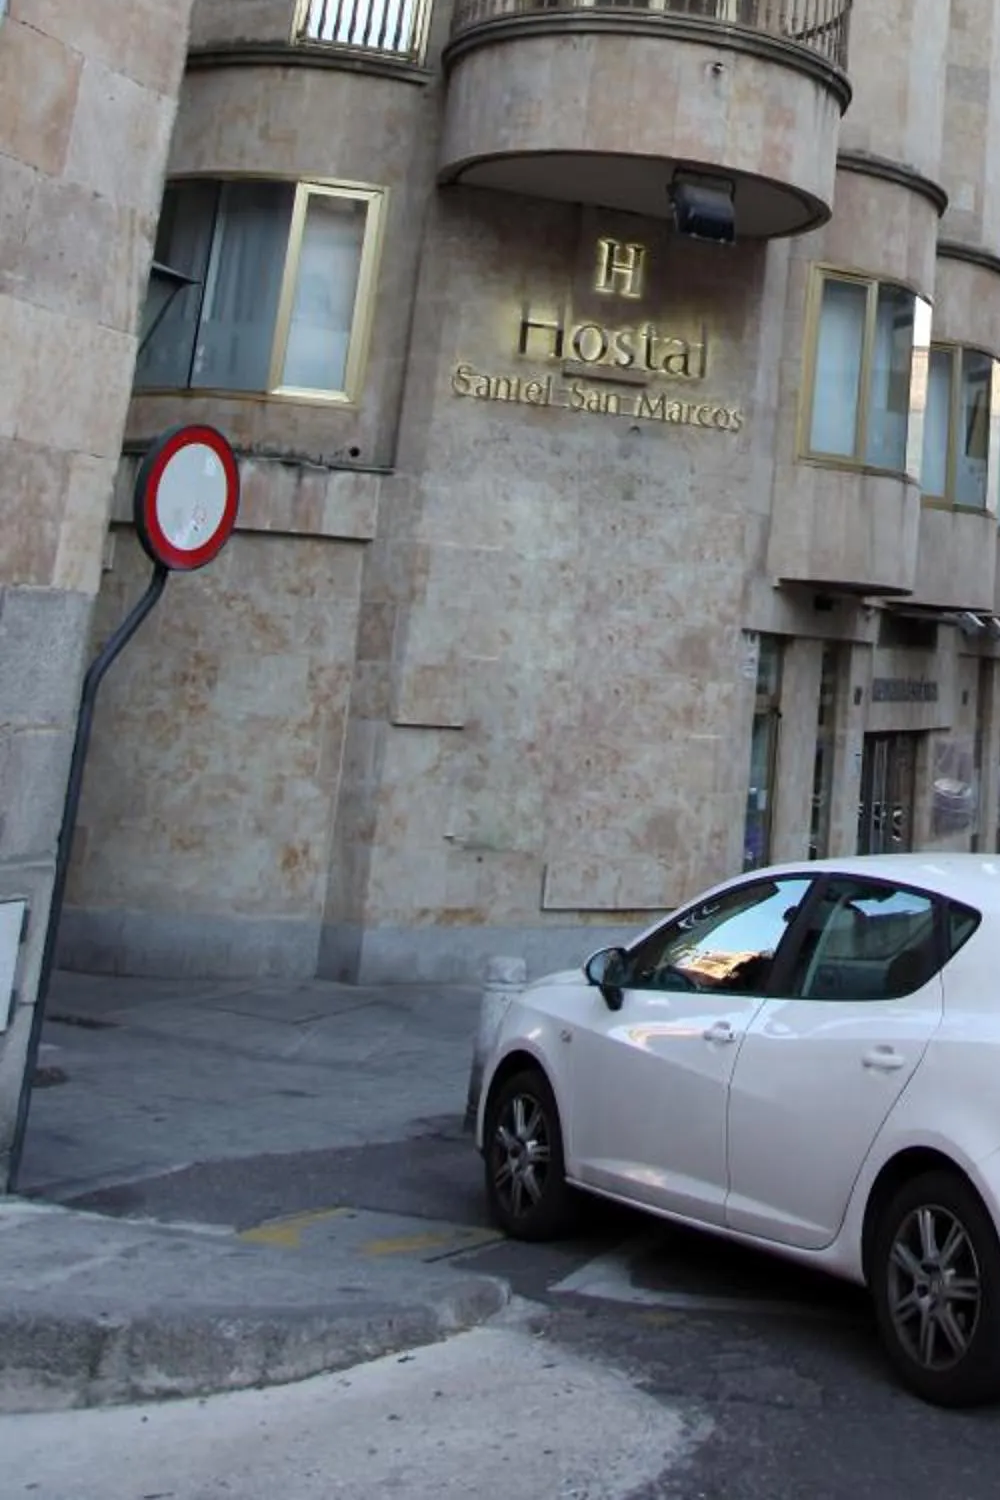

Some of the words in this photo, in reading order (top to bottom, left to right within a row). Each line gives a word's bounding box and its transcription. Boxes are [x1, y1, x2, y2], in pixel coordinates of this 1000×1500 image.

[595, 238, 648, 298] H
[518, 300, 708, 378] Hostal
[568, 380, 620, 414] San
[634, 390, 744, 432] Marcos
